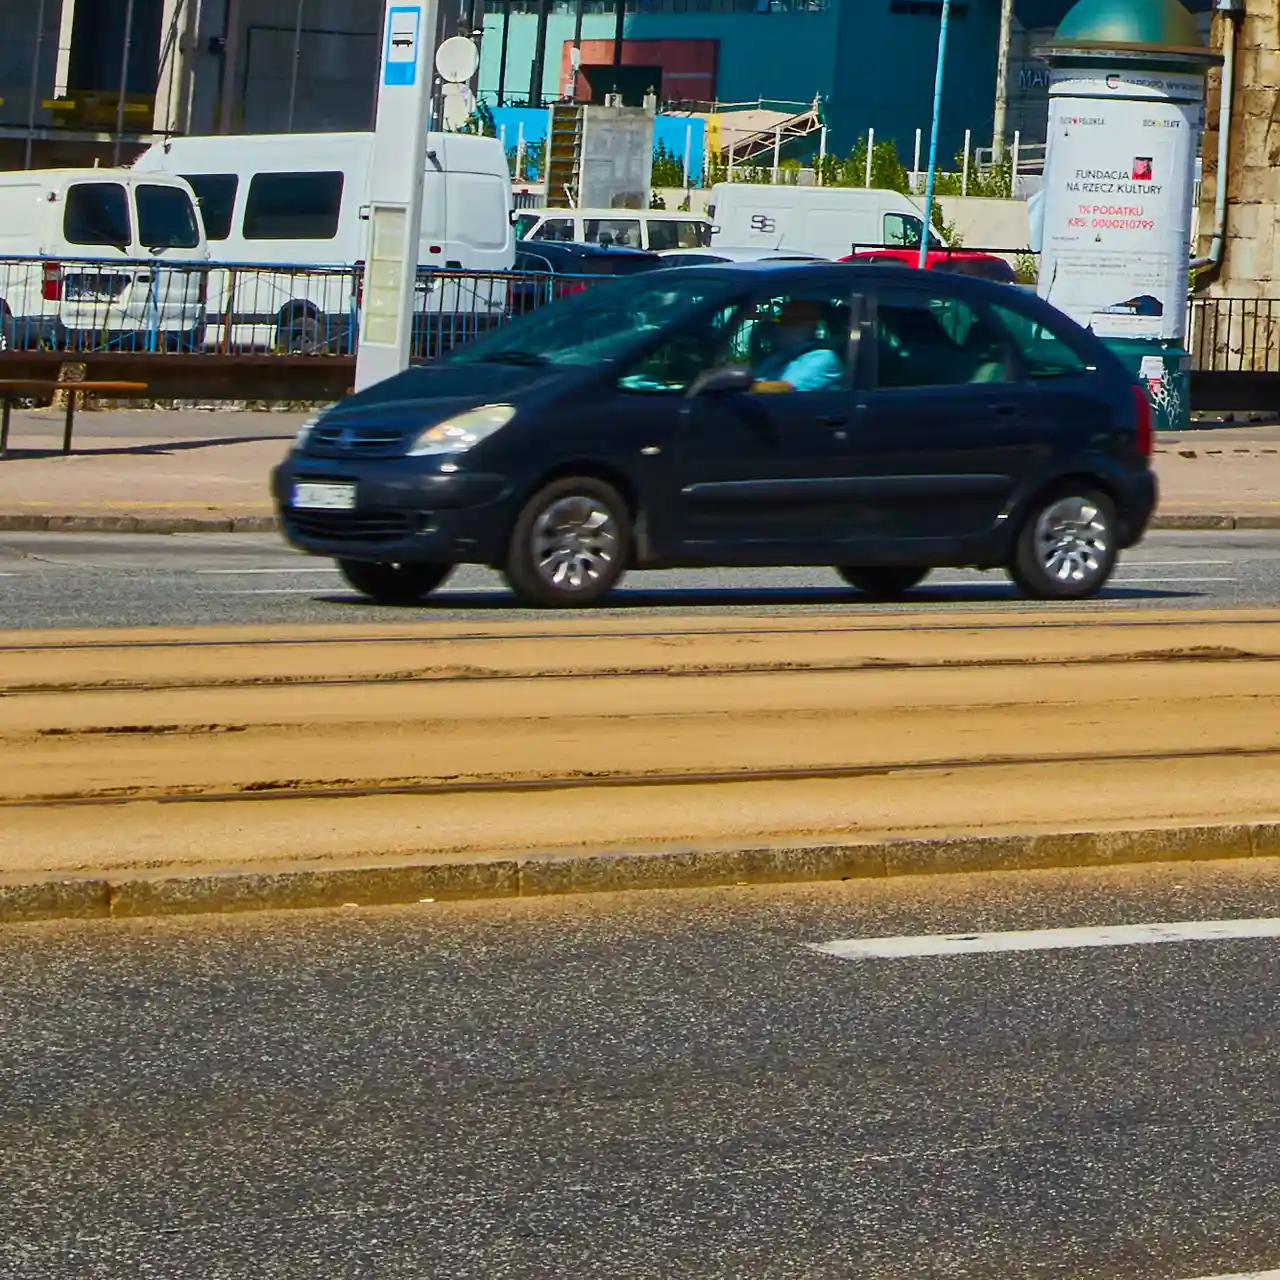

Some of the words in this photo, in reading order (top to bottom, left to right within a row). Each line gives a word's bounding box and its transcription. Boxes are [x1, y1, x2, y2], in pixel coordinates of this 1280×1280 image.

[1075, 169, 1130, 180] FUNDACJA
[1066, 182, 1080, 192] NA
[1082, 183, 1113, 193] RZECZ
[1117, 185, 1162, 195] KULTURY
[1092, 205, 1144, 217] PODATKU
